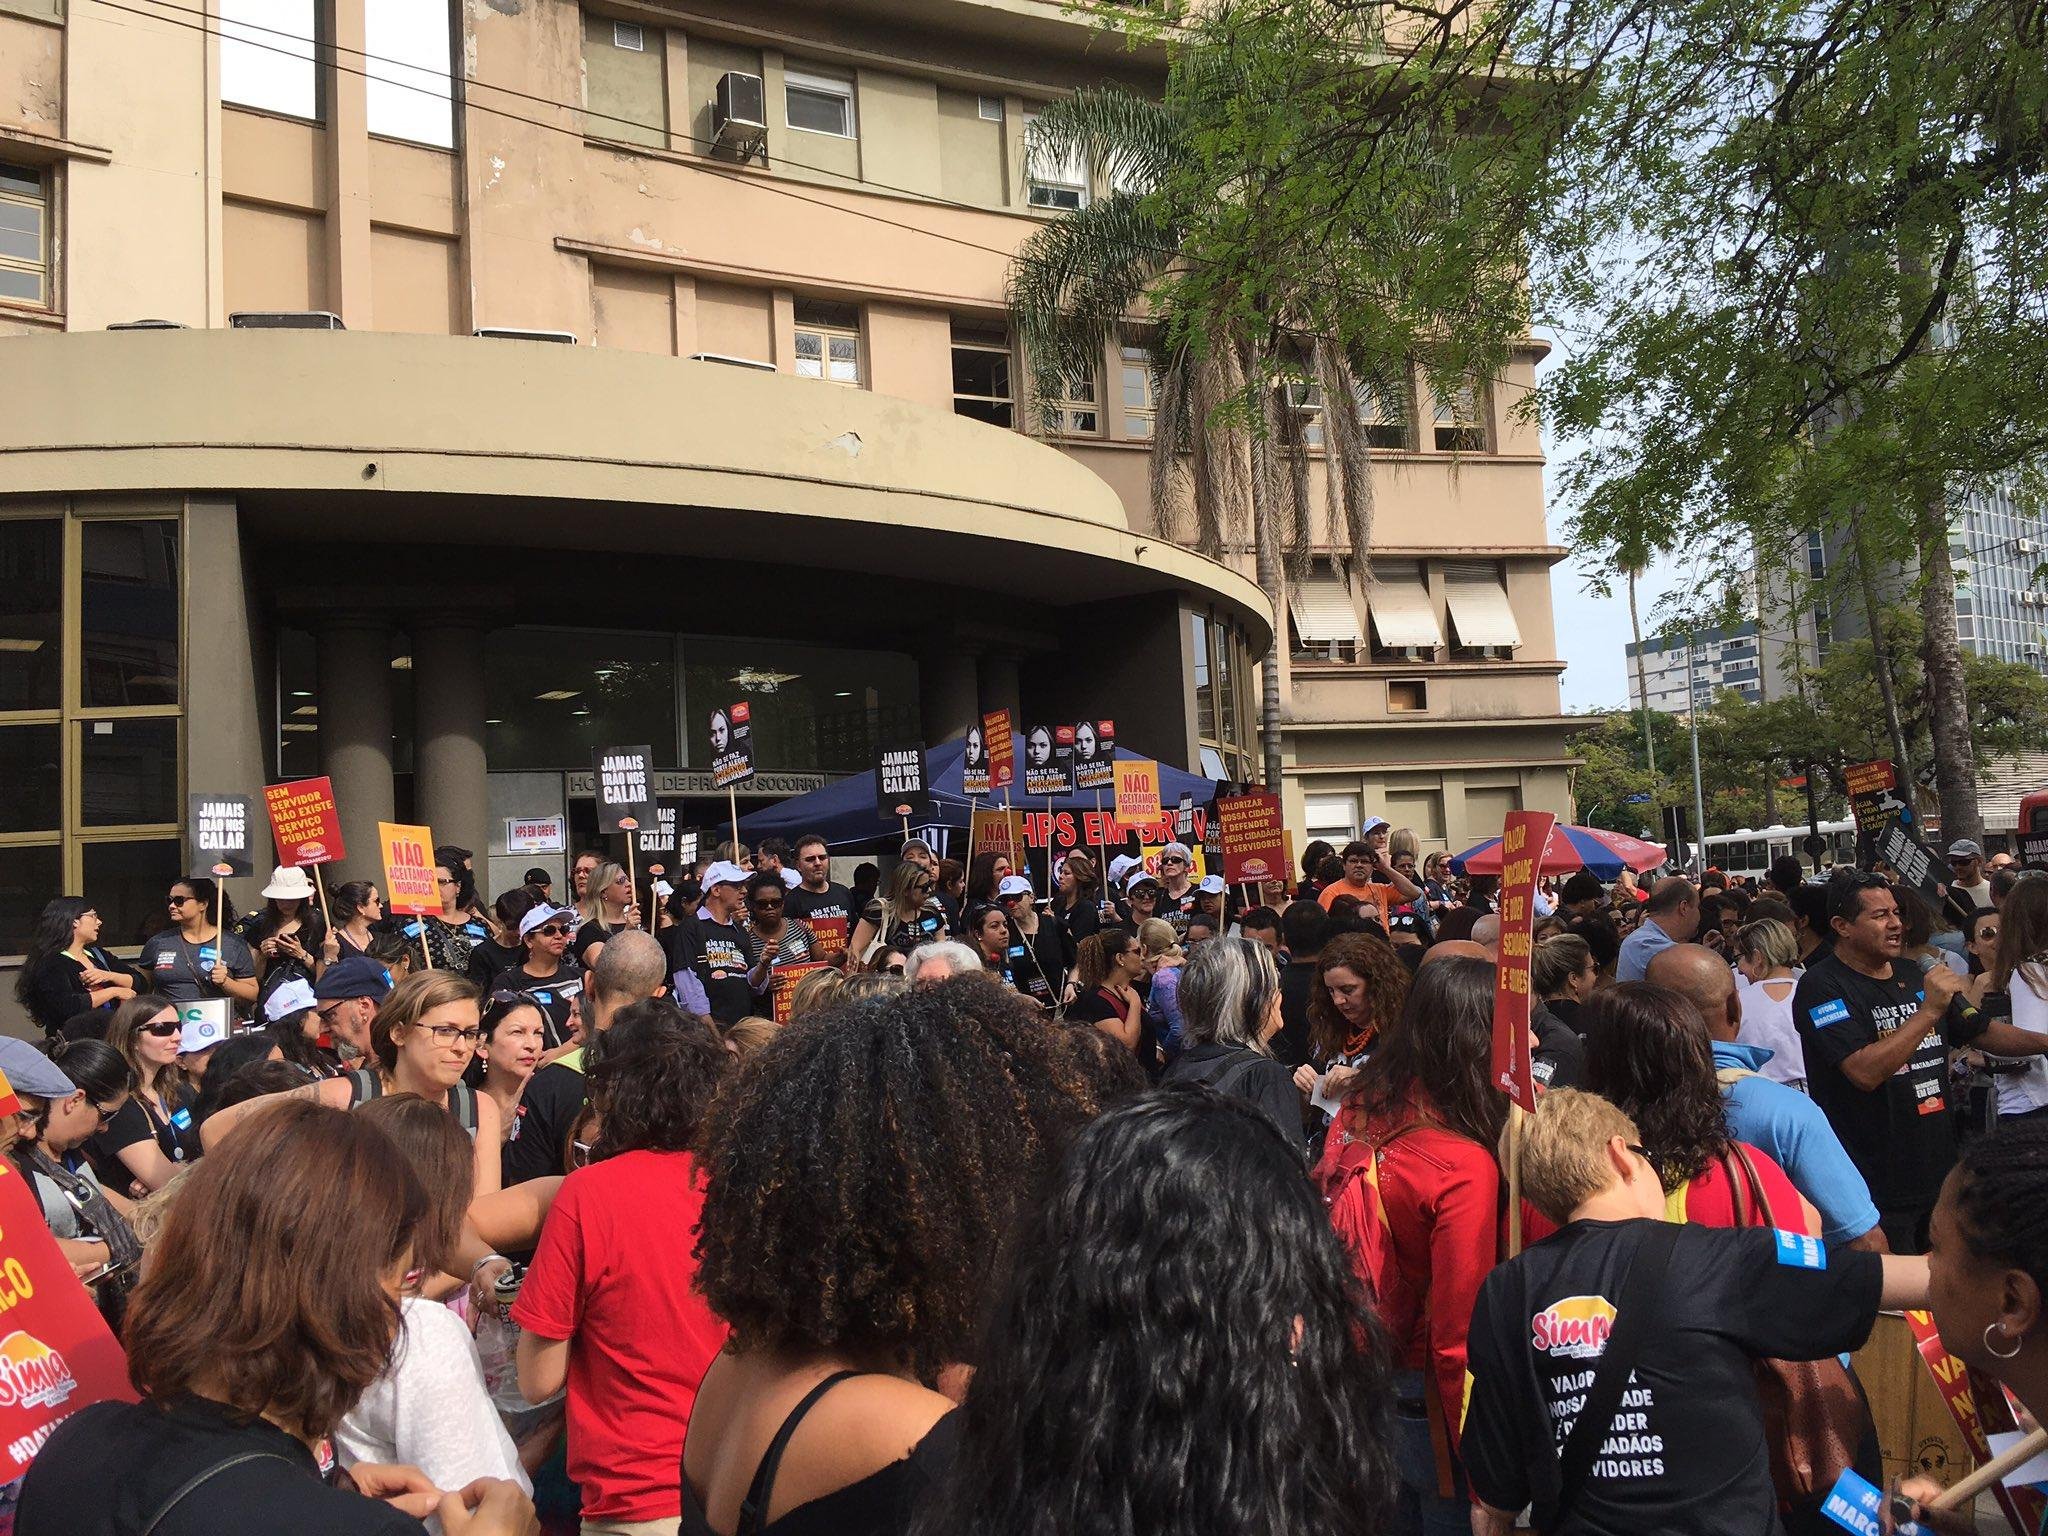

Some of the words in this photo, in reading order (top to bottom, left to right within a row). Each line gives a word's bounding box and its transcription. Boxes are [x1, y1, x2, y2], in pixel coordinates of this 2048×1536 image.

[601, 755, 645, 771] JAMAIS
[881, 750, 919, 766] JAMAIS
[882, 764, 902, 778] IRÃO
[903, 764, 920, 776] NOS
[1026, 768, 1039, 776] NÃO
[1075, 763, 1088, 771] NÃO
[602, 770, 625, 786] IRÃO
[626, 771, 646, 784] NOS
[757, 776, 822, 791] SOCORRO
[883, 776, 921, 793] CALAR
[1123, 770, 1149, 793] NÃO
[266, 787, 289, 800] SEM
[271, 791, 321, 811] SERVIDOR
[603, 785, 648, 804] CALAR
[1118, 793, 1158, 804] ACEITAMOS
[199, 802, 245, 818] JAMAIS
[274, 809, 296, 823] NÃO
[298, 800, 334, 816] EXISTE
[1219, 799, 1263, 812] VALORIZAR
[1220, 813, 1247, 823] NOSSA
[1248, 807, 1276, 818] CIDADE
[199, 817, 224, 832] IRÃO
[225, 818, 245, 832] NOS
[278, 815, 321, 834] SERVIÇO
[515, 825, 527, 838] HPS
[528, 825, 537, 837] EM
[538, 824, 556, 837] GREVE
[1022, 811, 1077, 847] HPS
[1084, 811, 1128, 846] EM
[1222, 822, 1228, 833] É
[1229, 819, 1270, 832] DEFENDER
[199, 831, 245, 850] CALAR
[281, 826, 325, 845] PÚBLICO
[640, 834, 674, 851] CALAR
[1206, 830, 1220, 839] POR
[1224, 833, 1243, 844] SEUS
[1244, 828, 1282, 841] CIDADÃOS
[392, 837, 424, 868] NÃO
[1226, 846, 1232, 855] E
[1233, 838, 1282, 853] SERVIDORES
[1885, 827, 1906, 864] JAMAIS
[390, 867, 435, 882] ACEITAMOS
[1906, 849, 1931, 887] CALAR
[810, 908, 822, 918] NÃO
[820, 938, 846, 949] XISTE
[778, 1001, 792, 1011] SEU
[1870, 1005, 1890, 1020] NÃO
[1899, 1002, 1919, 1016] FAZ
[1532, 1311, 1613, 1351] Simp
[1592, 1458, 1665, 1478] VIDORES
